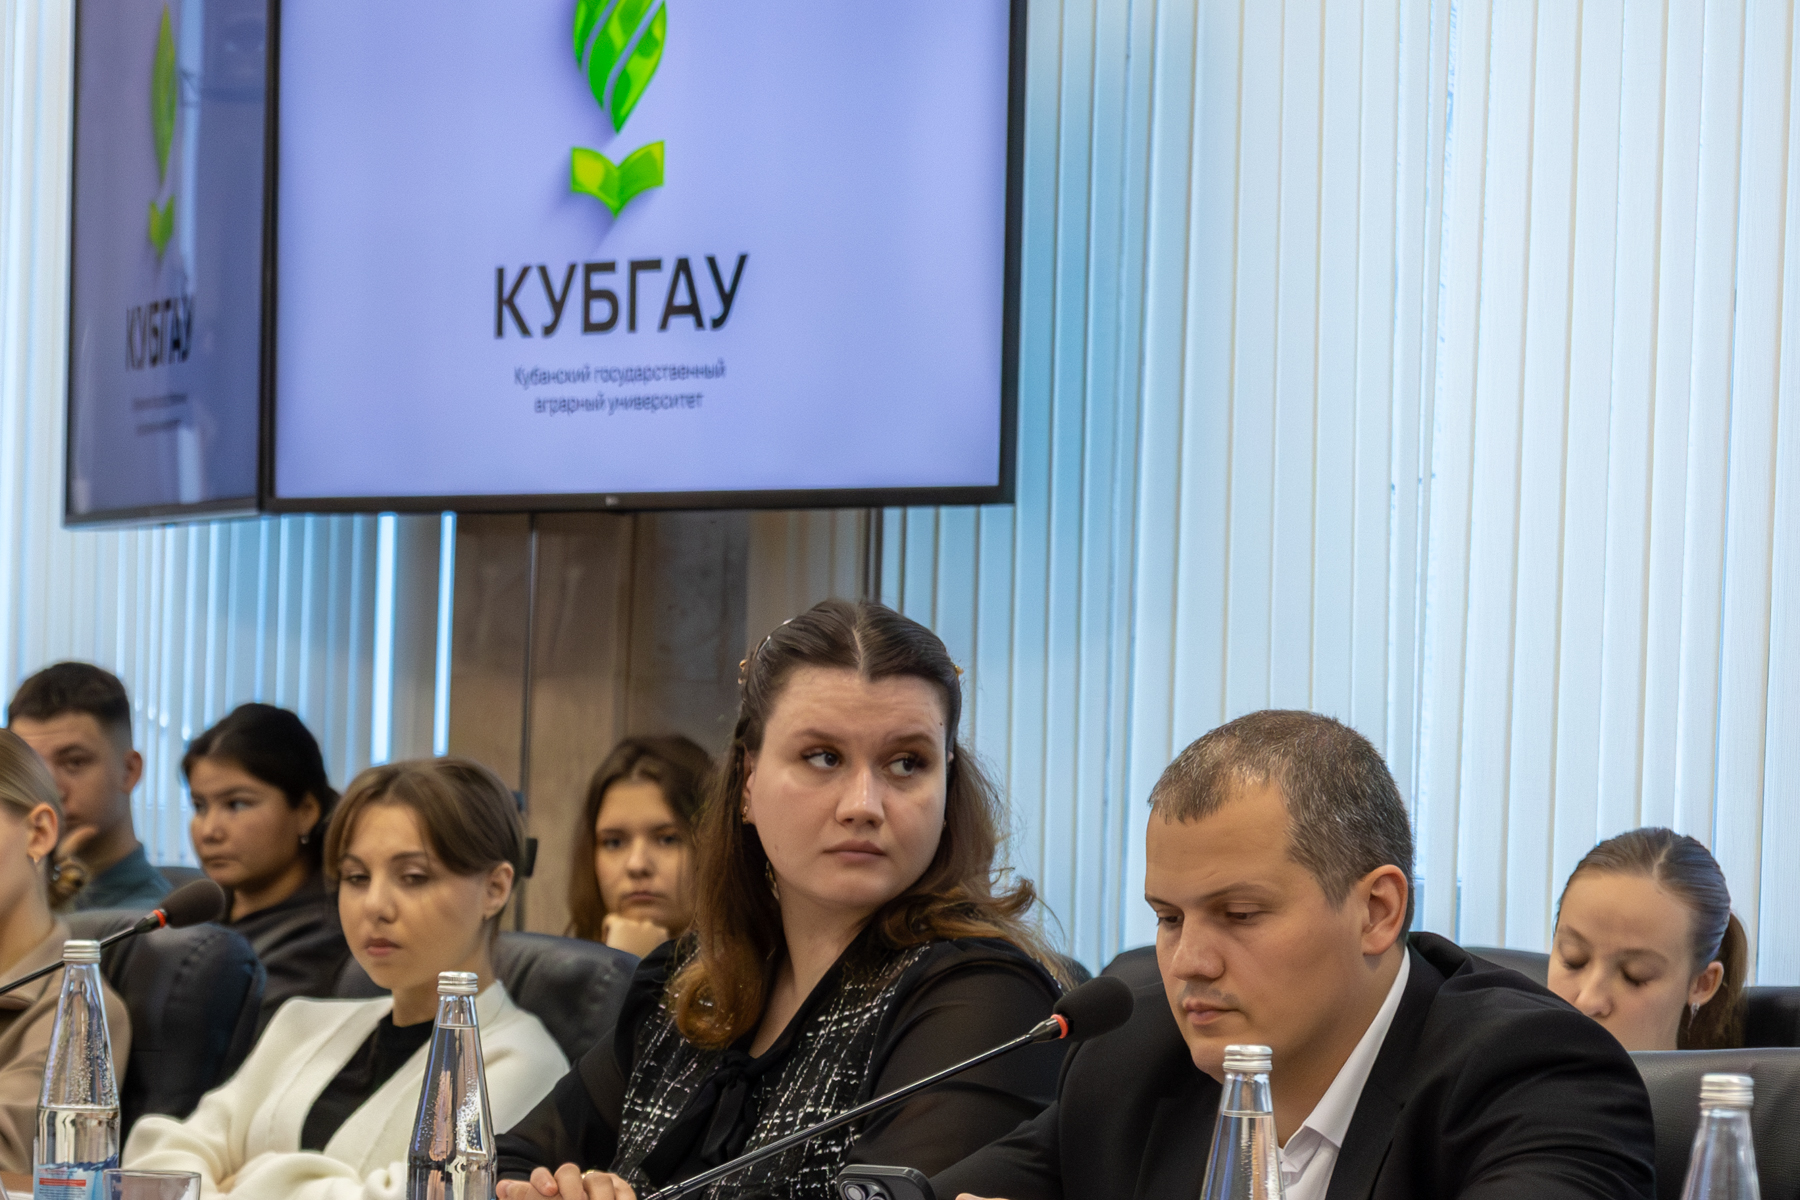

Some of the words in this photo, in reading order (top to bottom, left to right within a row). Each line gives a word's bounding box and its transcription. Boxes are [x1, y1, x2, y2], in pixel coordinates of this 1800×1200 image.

[493, 253, 749, 339] КУБГАУ
[126, 297, 194, 372] КУБГАУ
[513, 364, 591, 387] Кубанский
[593, 358, 727, 385] государственный
[533, 391, 606, 417] аграрный
[608, 389, 704, 416] университет
